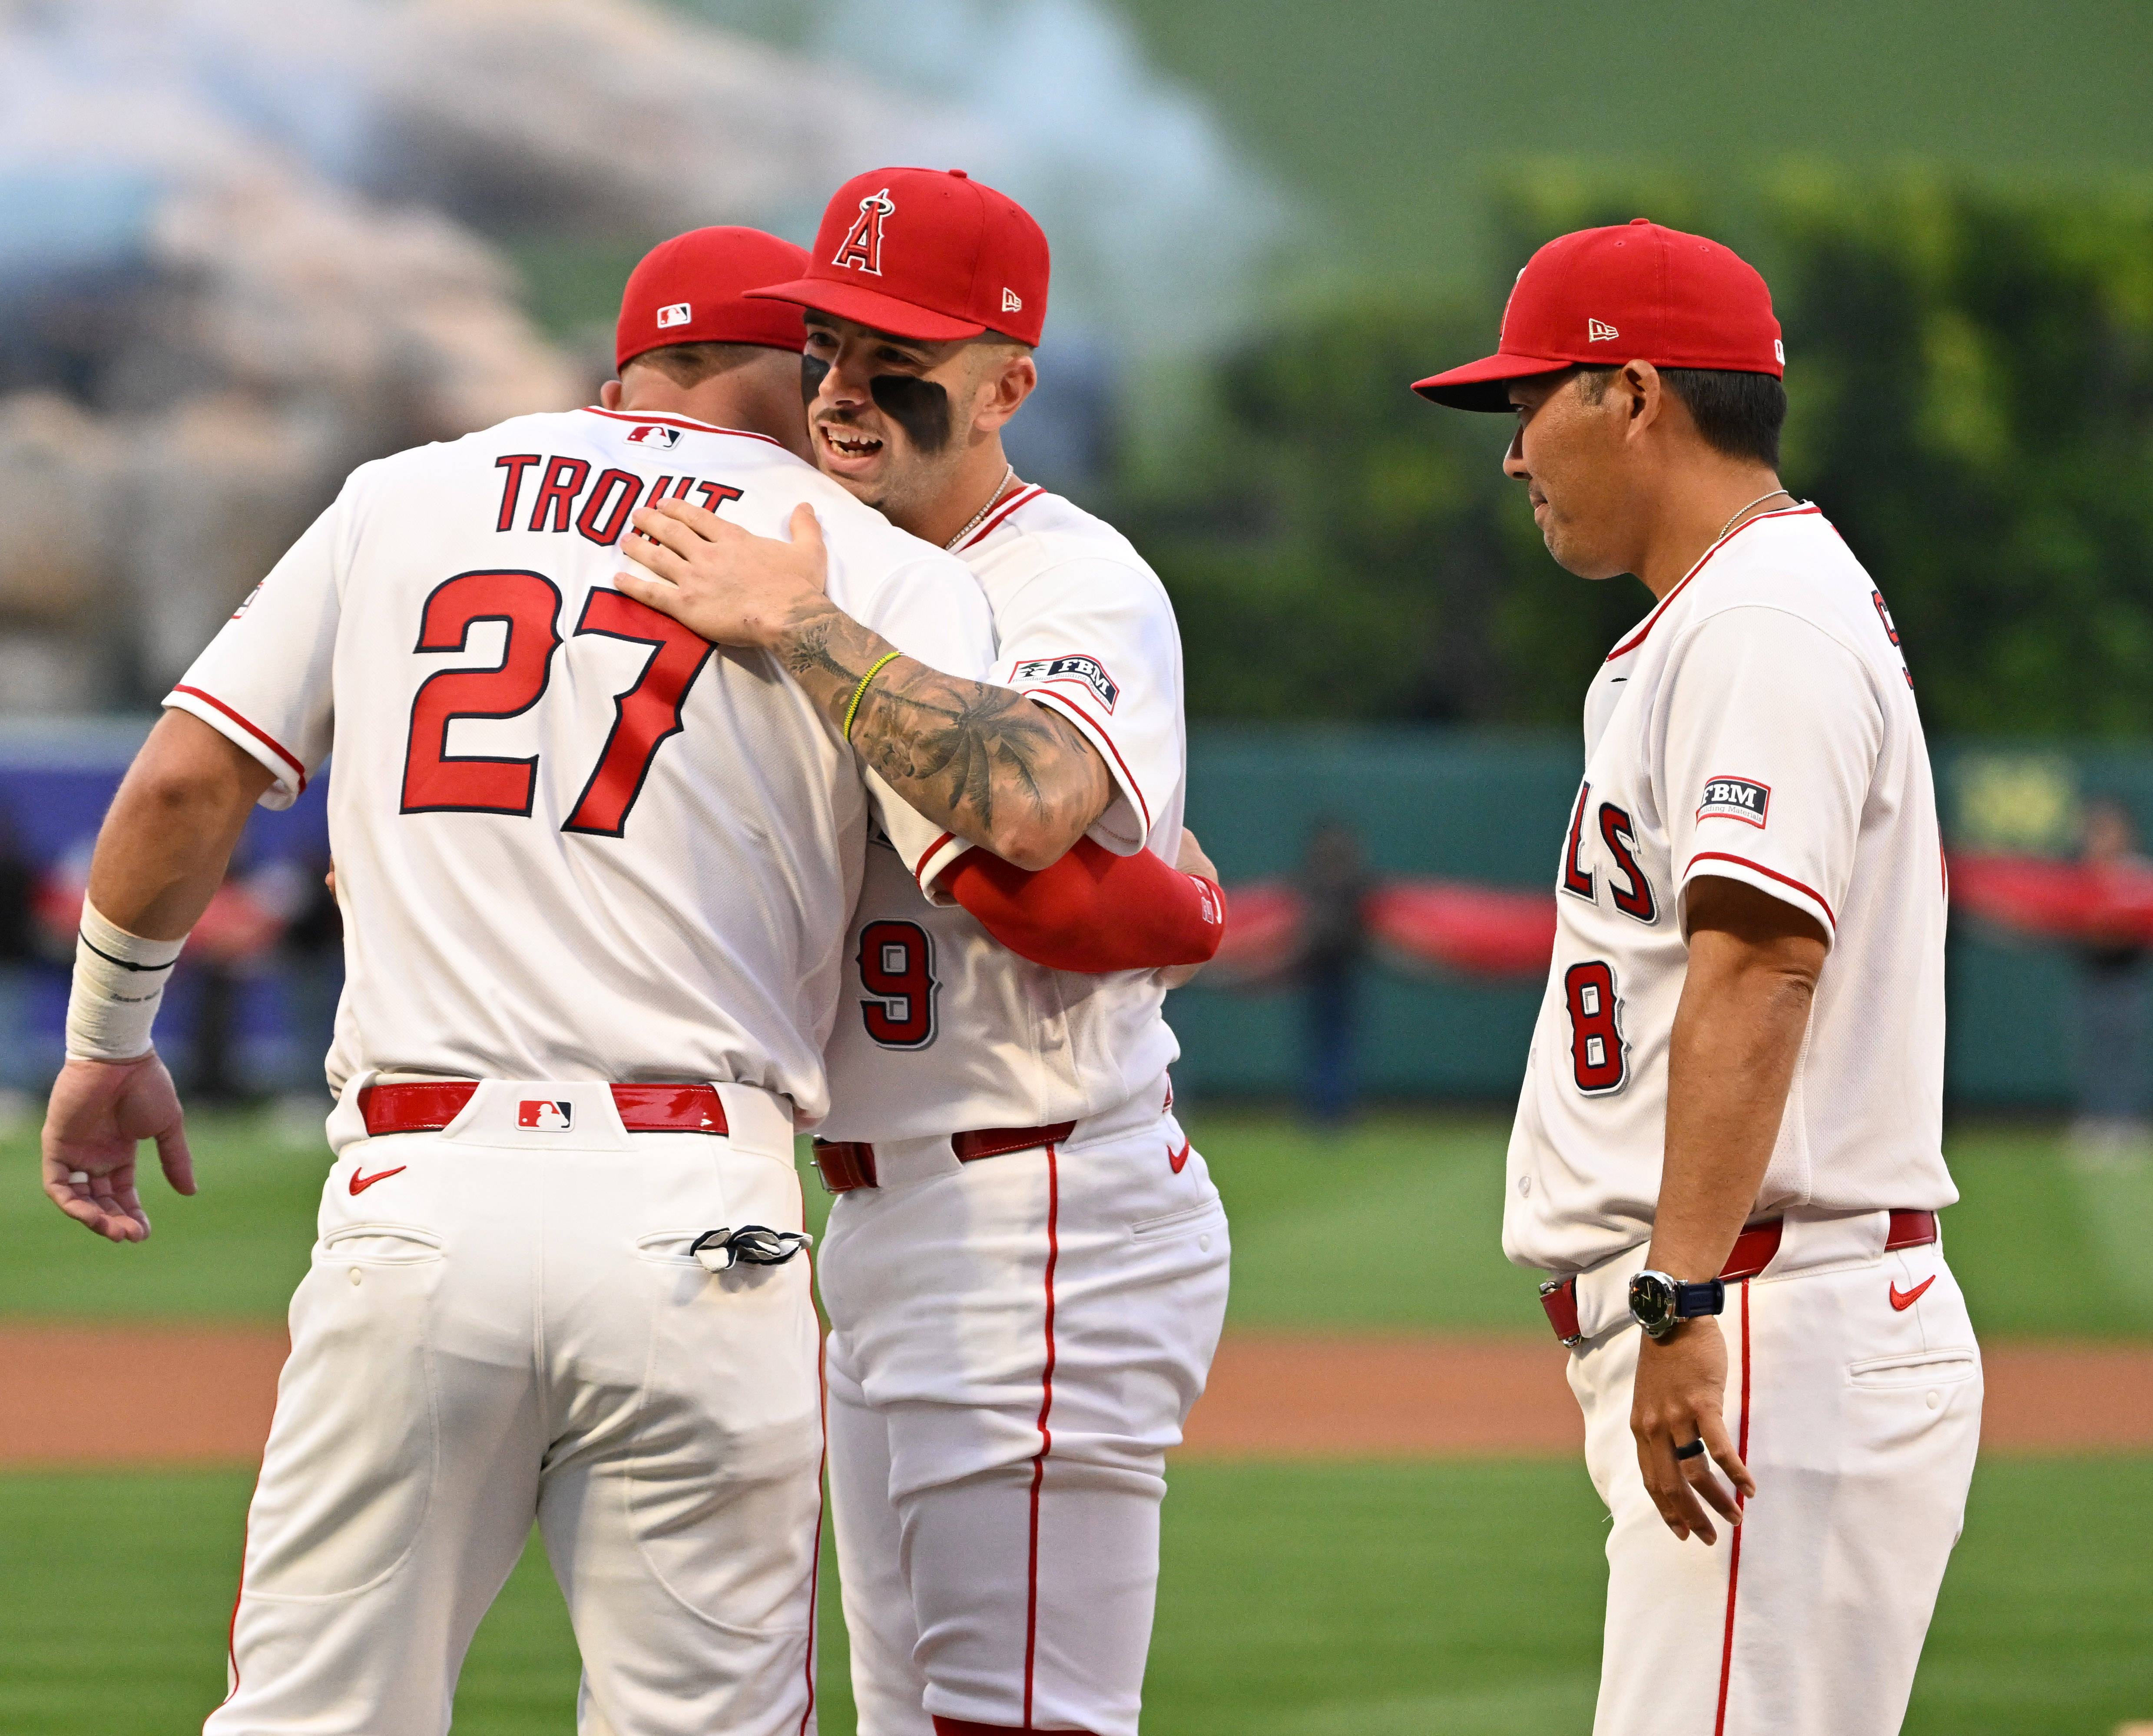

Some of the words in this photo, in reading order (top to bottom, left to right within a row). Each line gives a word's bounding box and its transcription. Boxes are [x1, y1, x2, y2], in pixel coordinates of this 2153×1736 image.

[831, 188, 895, 276] A
[400, 569, 719, 837] 27
[1056, 673, 1087, 682] Building
[1058, 659, 1110, 695] FBM
[1699, 805, 1725, 815] uilding
[1728, 806, 1762, 822] Materials
[1700, 784, 1757, 808] FBM
[856, 919, 942, 1050] 9
[1564, 960, 1632, 1098] 8
